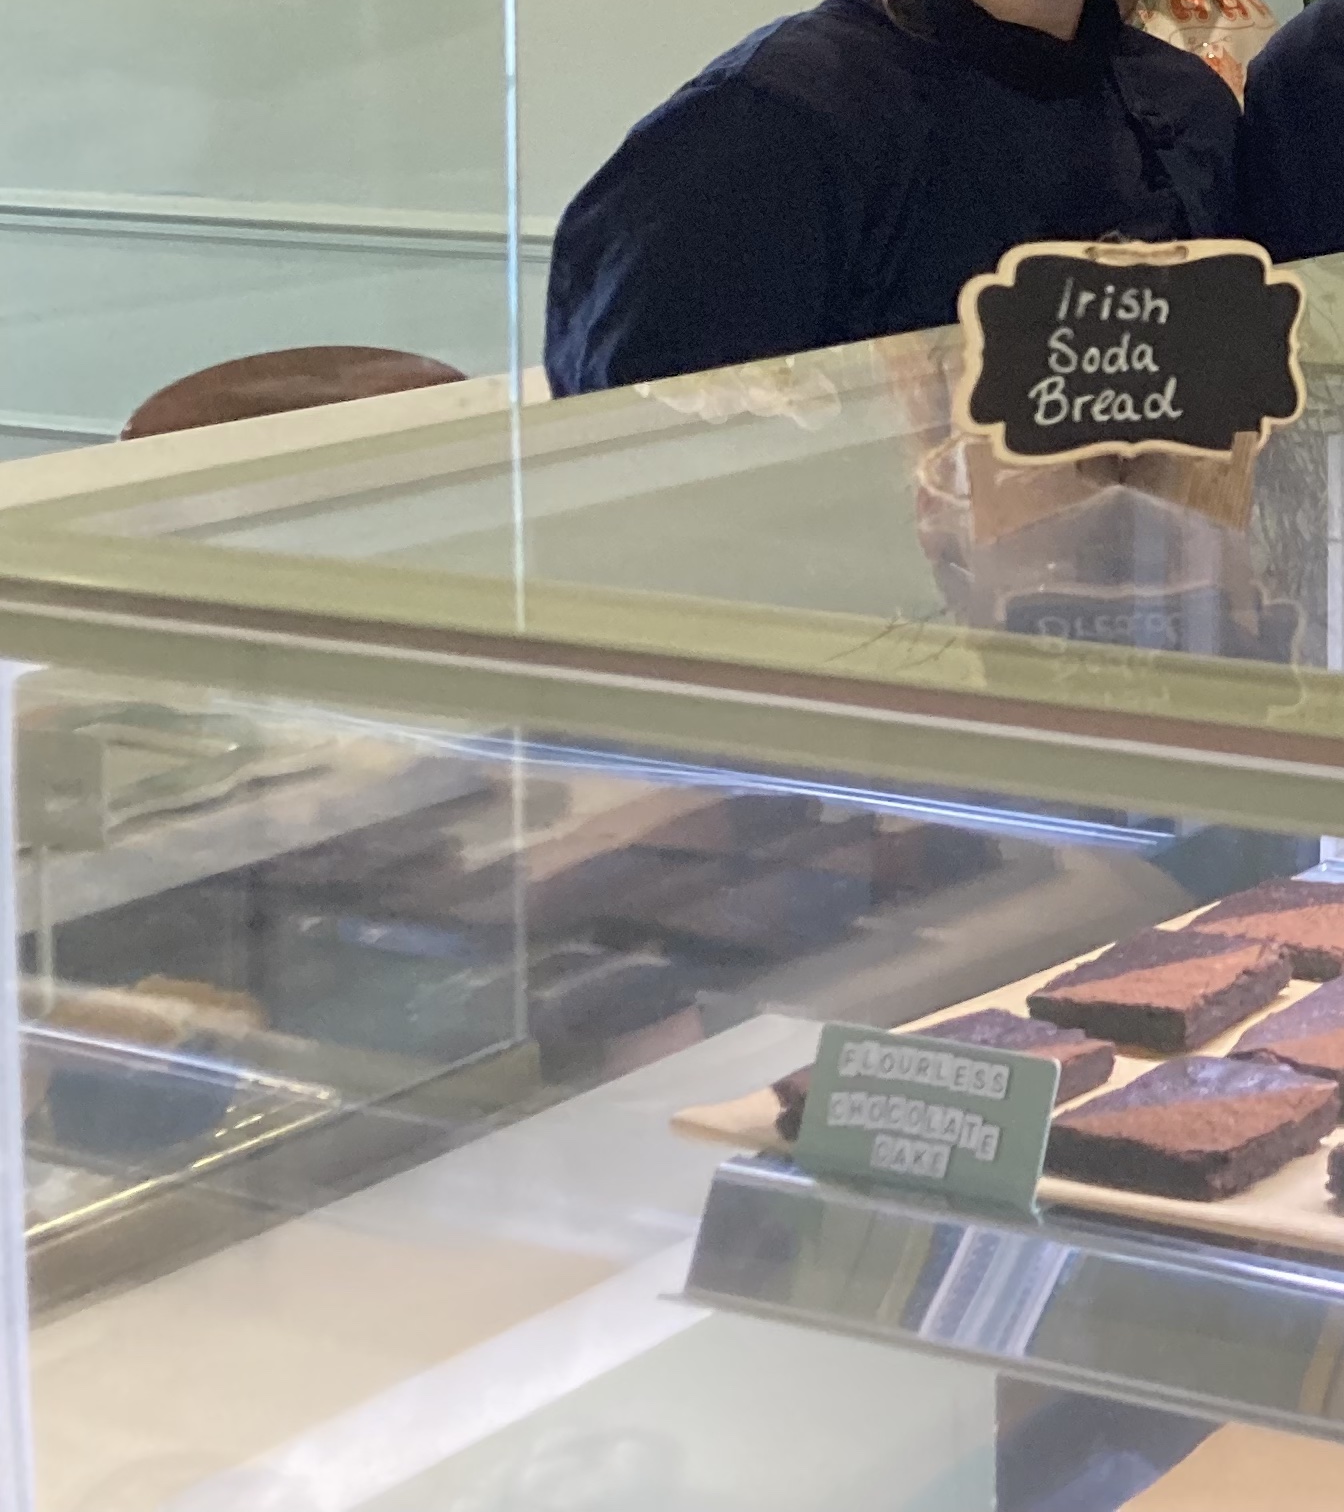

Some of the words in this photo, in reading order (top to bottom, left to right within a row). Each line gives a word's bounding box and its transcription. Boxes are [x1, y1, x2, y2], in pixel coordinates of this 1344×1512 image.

[1055, 276, 1171, 325] Irish
[1047, 326, 1160, 375] Soda
[1027, 375, 1184, 426] Bread
[841, 1044, 1007, 1095] FLOURLESS
[829, 1095, 998, 1158] CHOCOLATE
[874, 1138, 947, 1175] CAKE
